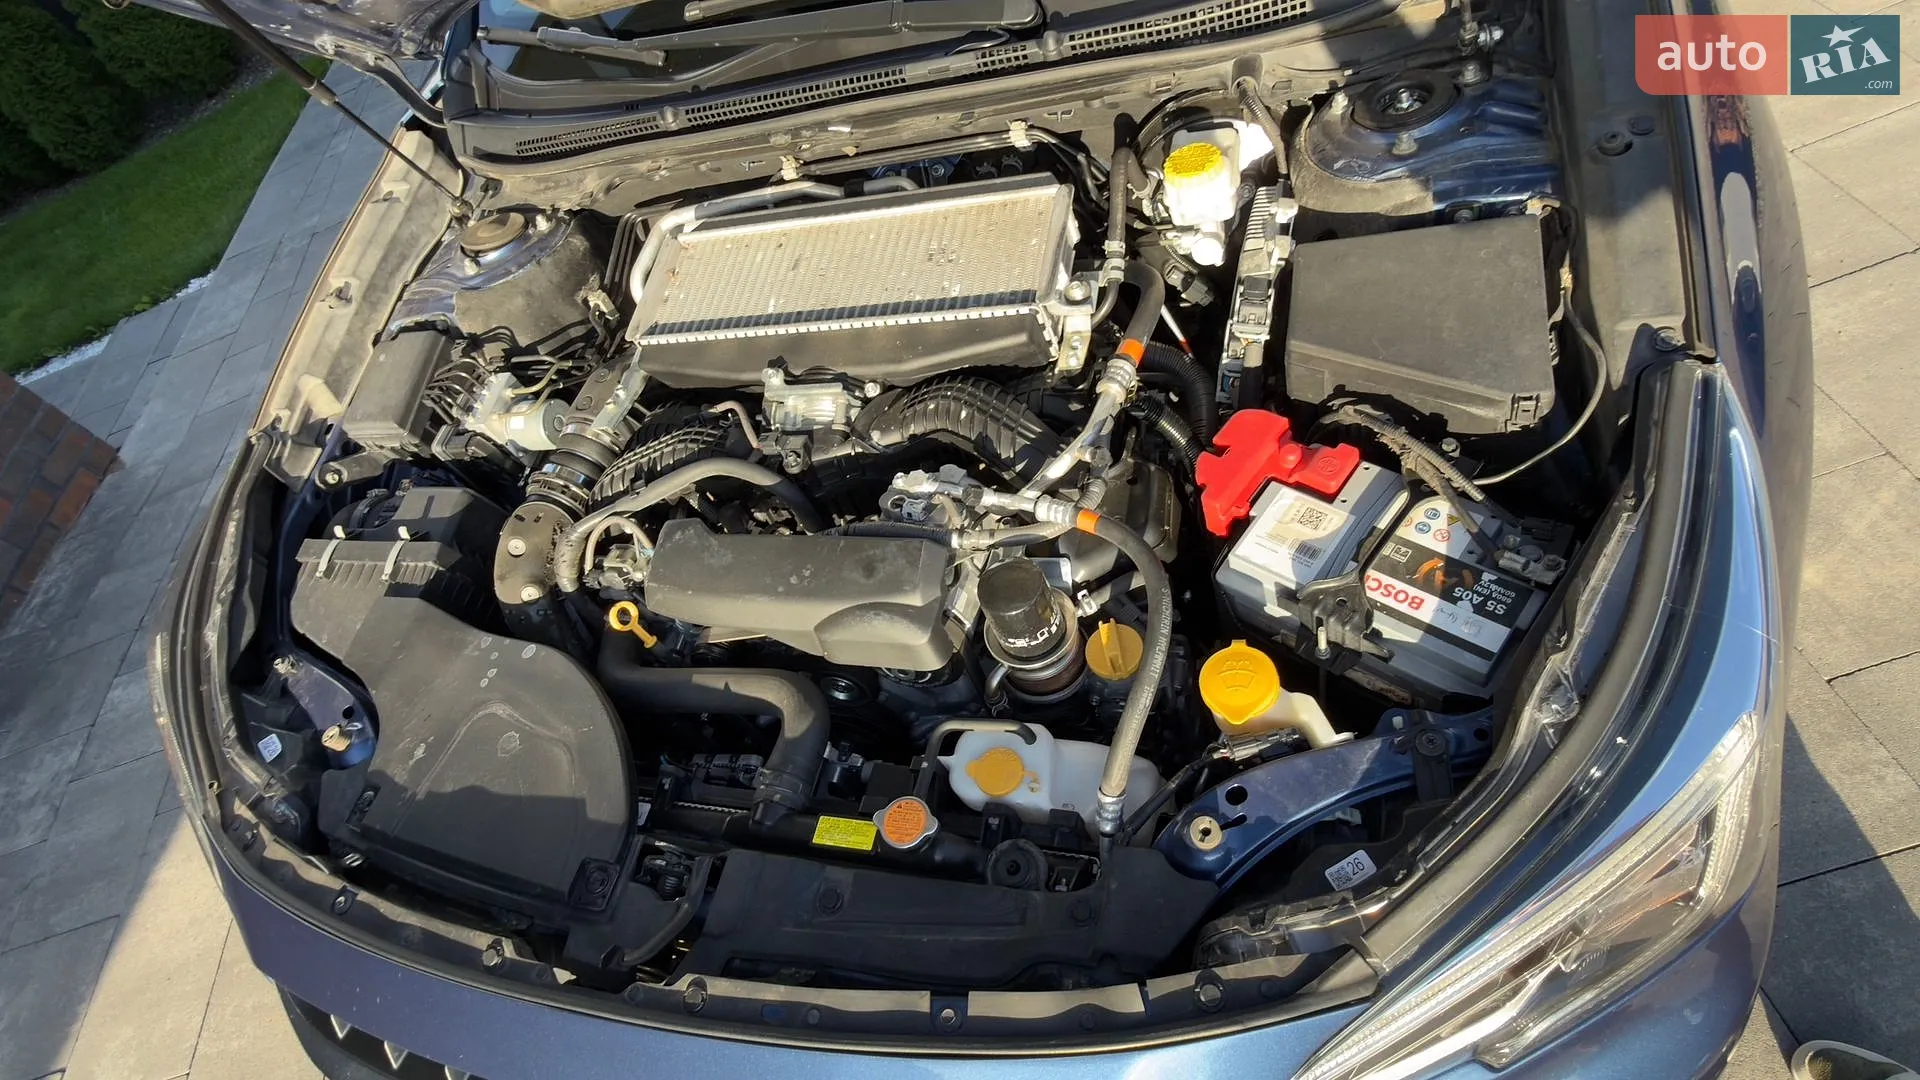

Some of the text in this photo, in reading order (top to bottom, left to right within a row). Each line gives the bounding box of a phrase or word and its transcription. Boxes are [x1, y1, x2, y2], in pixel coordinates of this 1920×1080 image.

[1452, 587, 1508, 615] S5 A05
[1346, 857, 1365, 875] 26
